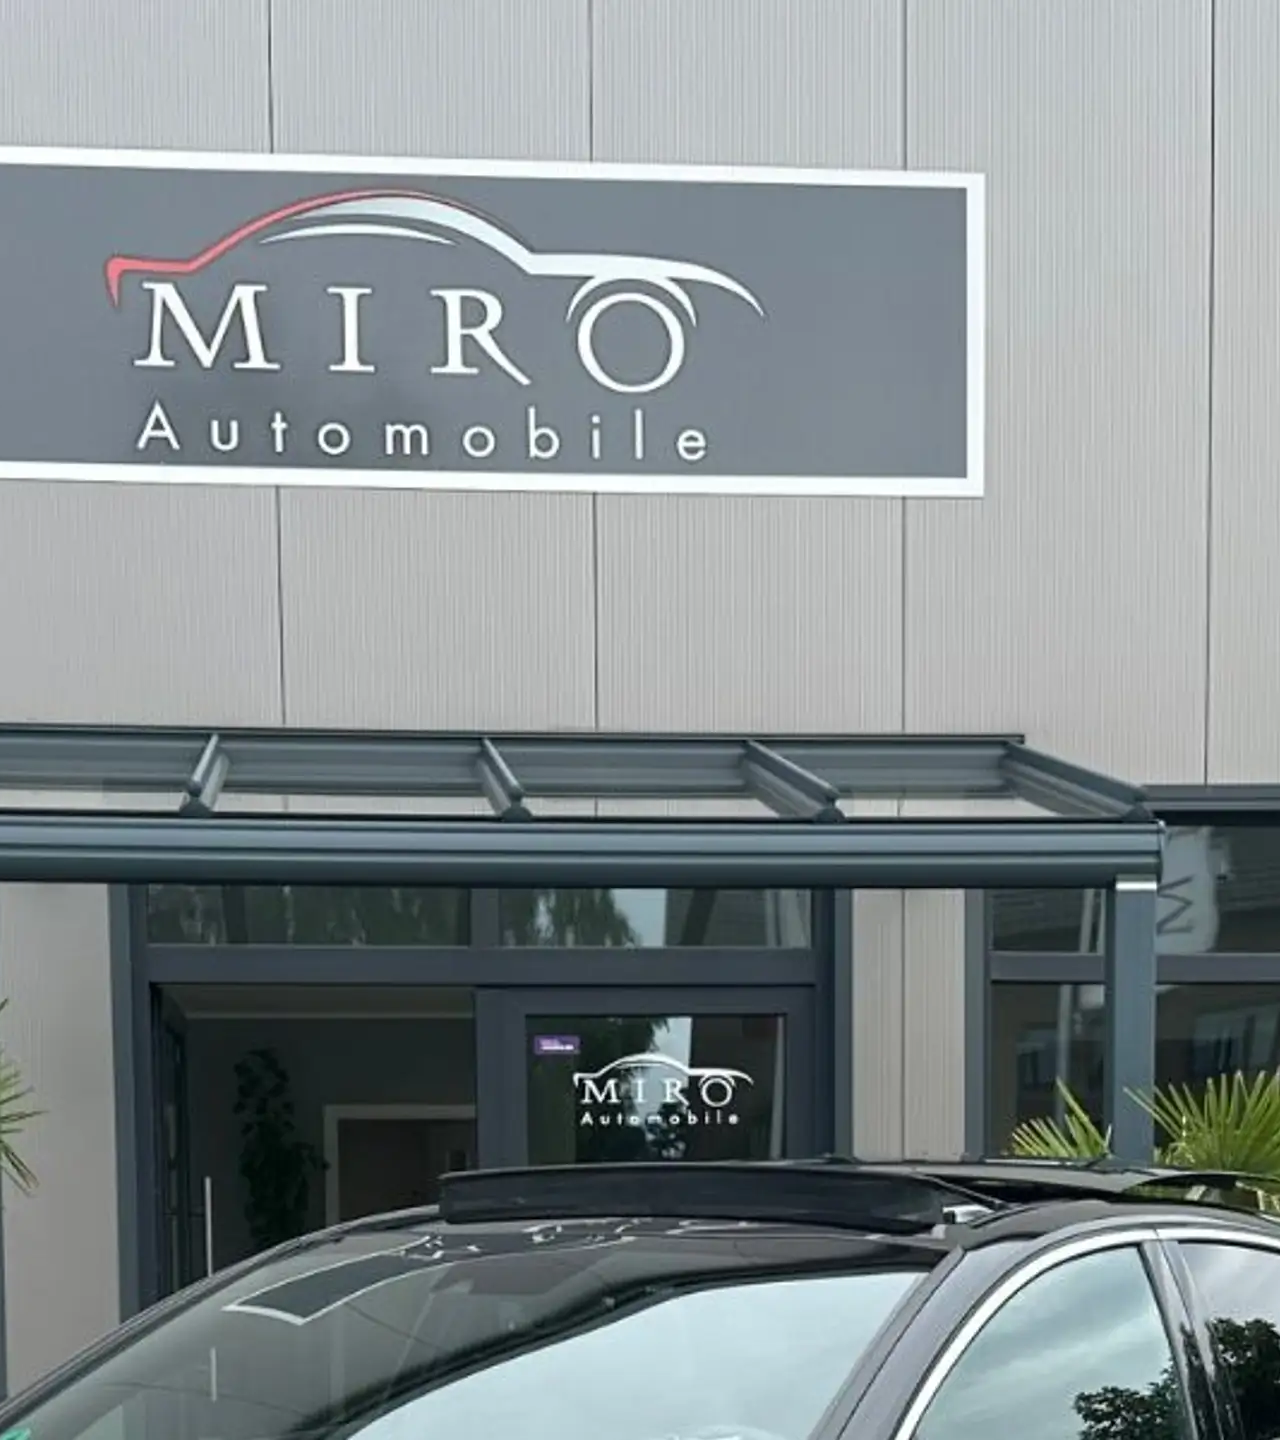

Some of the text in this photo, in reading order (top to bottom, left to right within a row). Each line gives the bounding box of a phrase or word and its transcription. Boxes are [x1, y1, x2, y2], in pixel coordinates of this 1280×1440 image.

[134, 280, 687, 394] MIRO
[136, 401, 708, 462] Automobile
[580, 1077, 733, 1107] MIRO
[580, 1111, 739, 1126] Automobile
